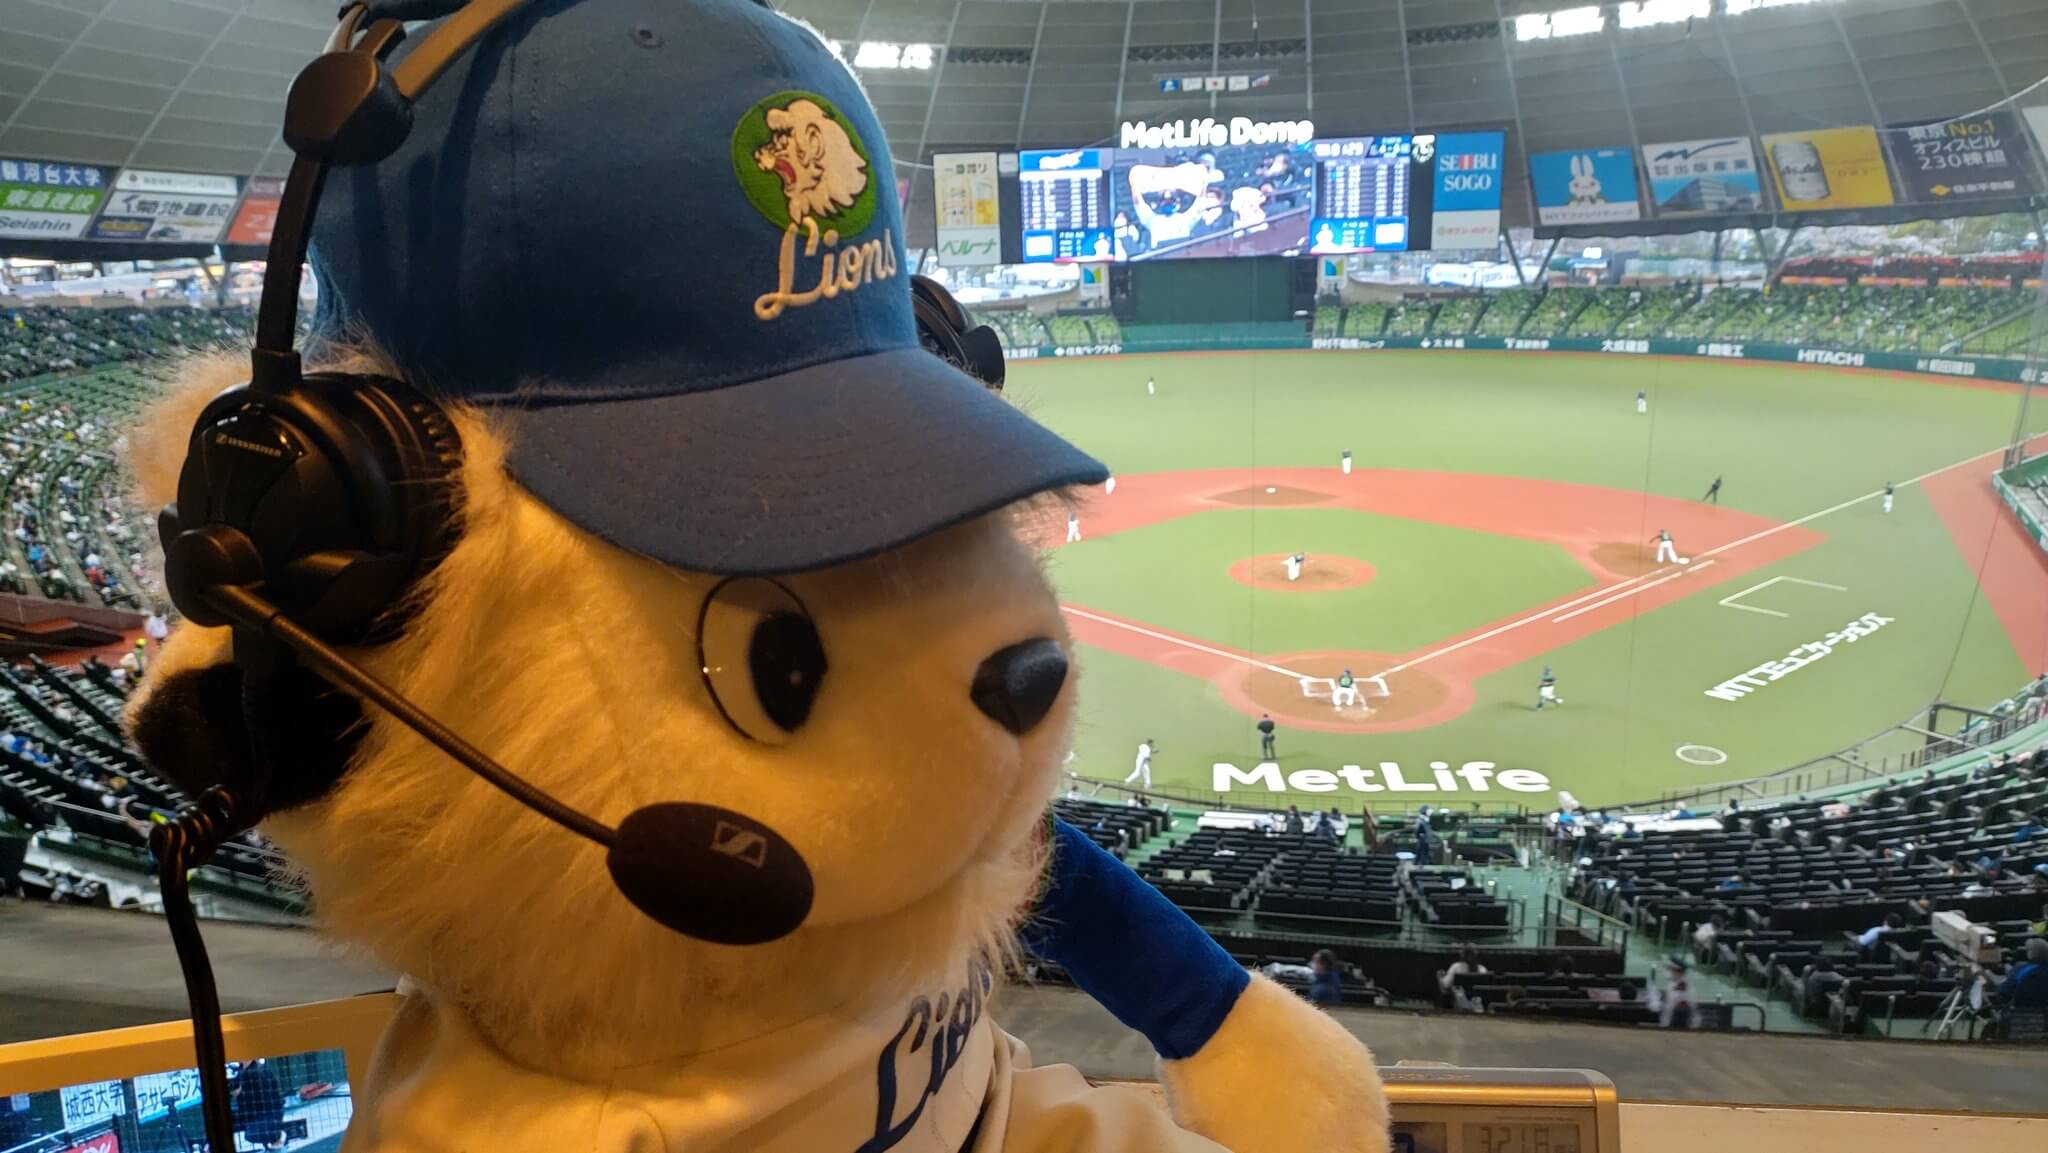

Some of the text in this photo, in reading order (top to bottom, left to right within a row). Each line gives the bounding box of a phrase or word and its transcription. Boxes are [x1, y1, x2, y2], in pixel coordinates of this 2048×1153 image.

[1121, 117, 1314, 149] MetLife Dome
[1913, 136, 2000, 155] オフィスビル
[1440, 153, 1497, 171] SEIBU
[1444, 175, 1492, 192] SOGO
[0, 216, 72, 232] Seishin
[941, 238, 997, 255] ベルーナ
[754, 215, 897, 321] Lions
[1798, 349, 1864, 367] HITACHI
[1213, 761, 1551, 792] MetLife
[64, 1082, 124, 1121] 城西大学
